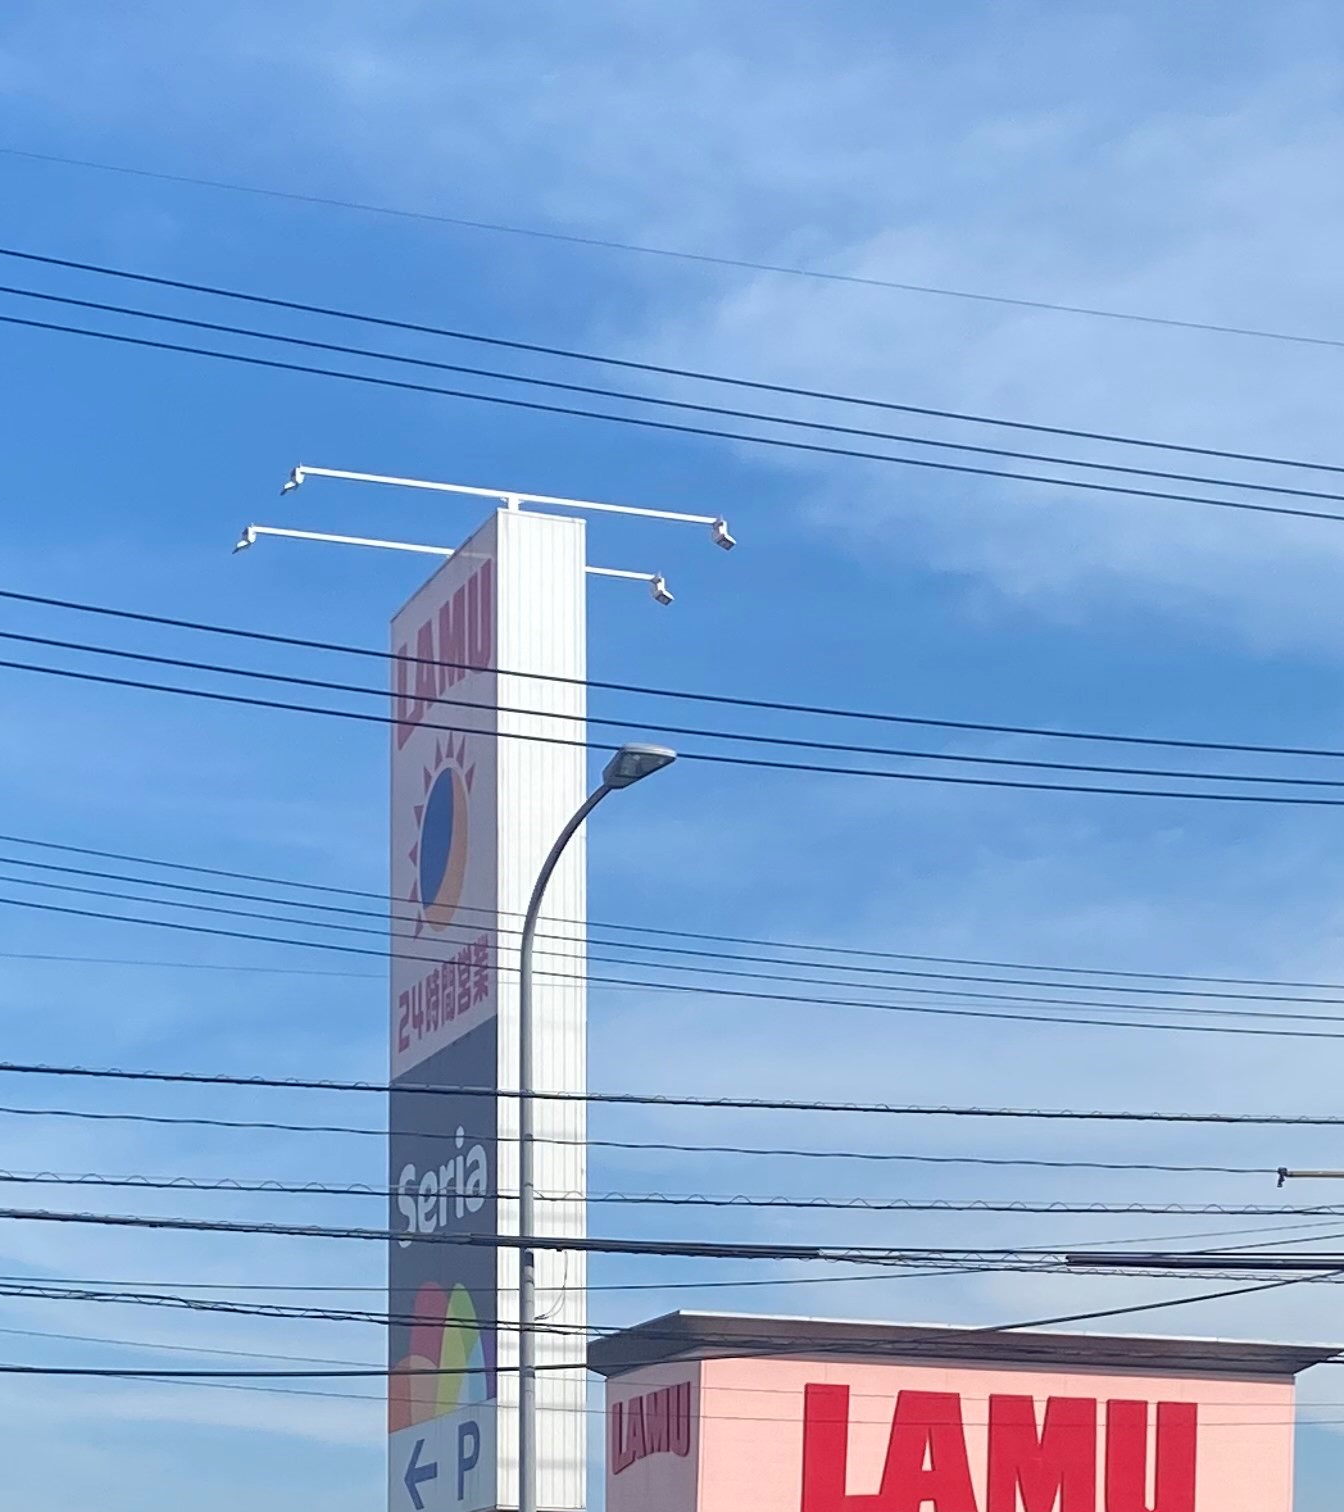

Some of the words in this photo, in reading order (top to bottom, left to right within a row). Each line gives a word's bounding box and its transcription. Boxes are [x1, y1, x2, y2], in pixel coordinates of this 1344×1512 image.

[397, 558, 492, 751] LAMU
[399, 934, 489, 1053] 24時間営業
[398, 1125, 487, 1248] Seria
[457, 1420, 480, 1500] P
[612, 1381, 691, 1475] LAMU
